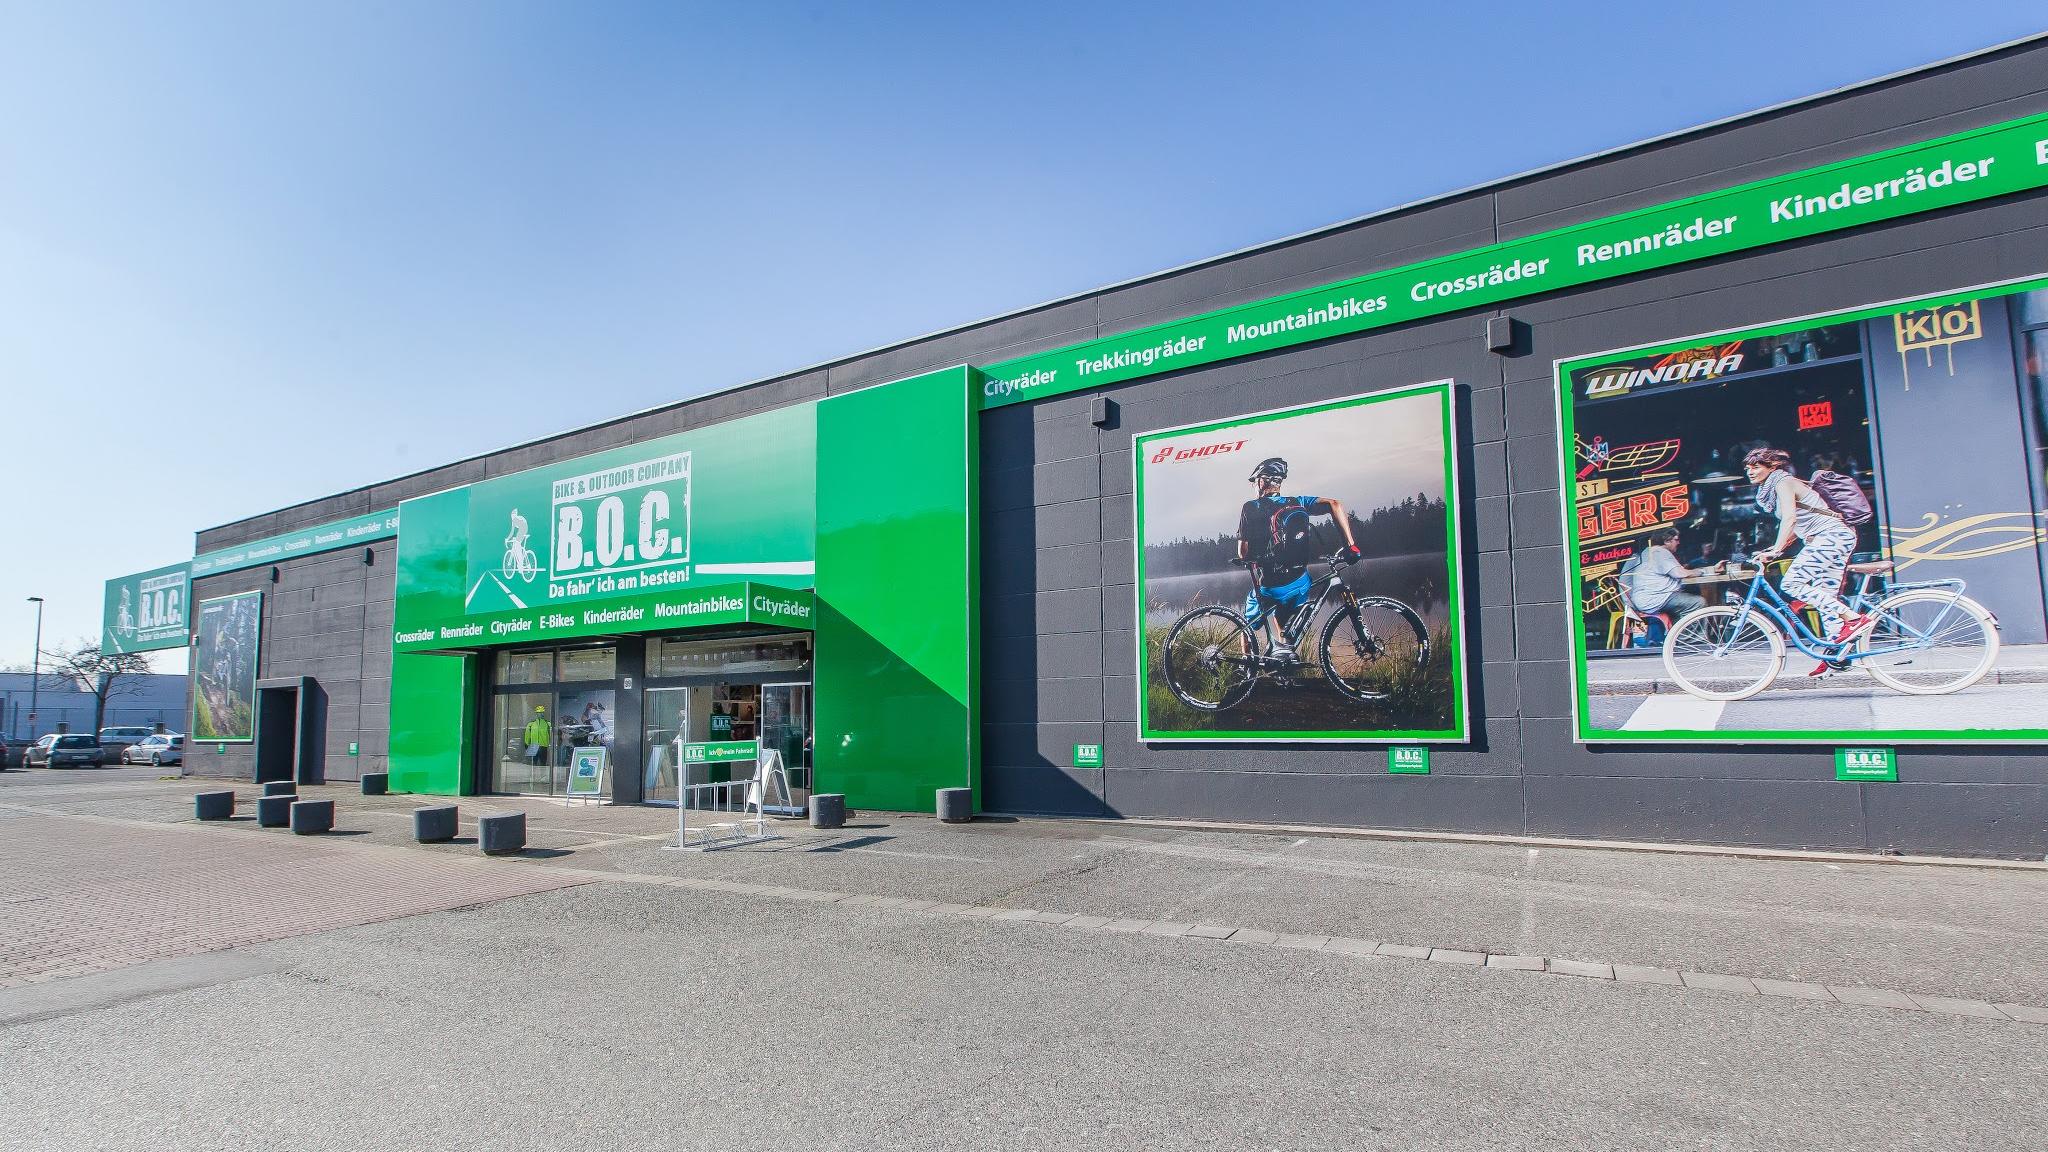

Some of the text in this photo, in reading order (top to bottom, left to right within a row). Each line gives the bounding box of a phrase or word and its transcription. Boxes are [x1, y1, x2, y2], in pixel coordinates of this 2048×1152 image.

[983, 366, 1058, 397] Cityräder
[1075, 333, 1207, 377] Trekkingräder
[1226, 293, 1388, 345] Mountainbikes
[1410, 257, 1550, 303] Crossräder
[1576, 213, 1738, 266] Rennräder
[1769, 156, 1995, 224] Kinderräder
[1584, 353, 1745, 396] WINORA
[1174, 439, 1248, 461] GHOST
[554, 456, 690, 499] BIKE & OUTDOOR COMPANY
[556, 489, 683, 572] B.O.C.
[1577, 484, 1689, 539] GERS
[1581, 546, 1632, 564] & shakes
[549, 583, 565, 599] Da
[597, 576, 615, 593] ich
[618, 576, 637, 590] am
[640, 565, 690, 588] besten!
[141, 588, 182, 628] B.O.C.
[395, 595, 744, 644] Crossräder Rennräder Cityräder E-Bikes Kinderräder Mountainbikes
[753, 595, 810, 618] Cityräder
[1396, 750, 1422, 760] B.O.C.
[1847, 752, 1885, 765] B.O.C.
